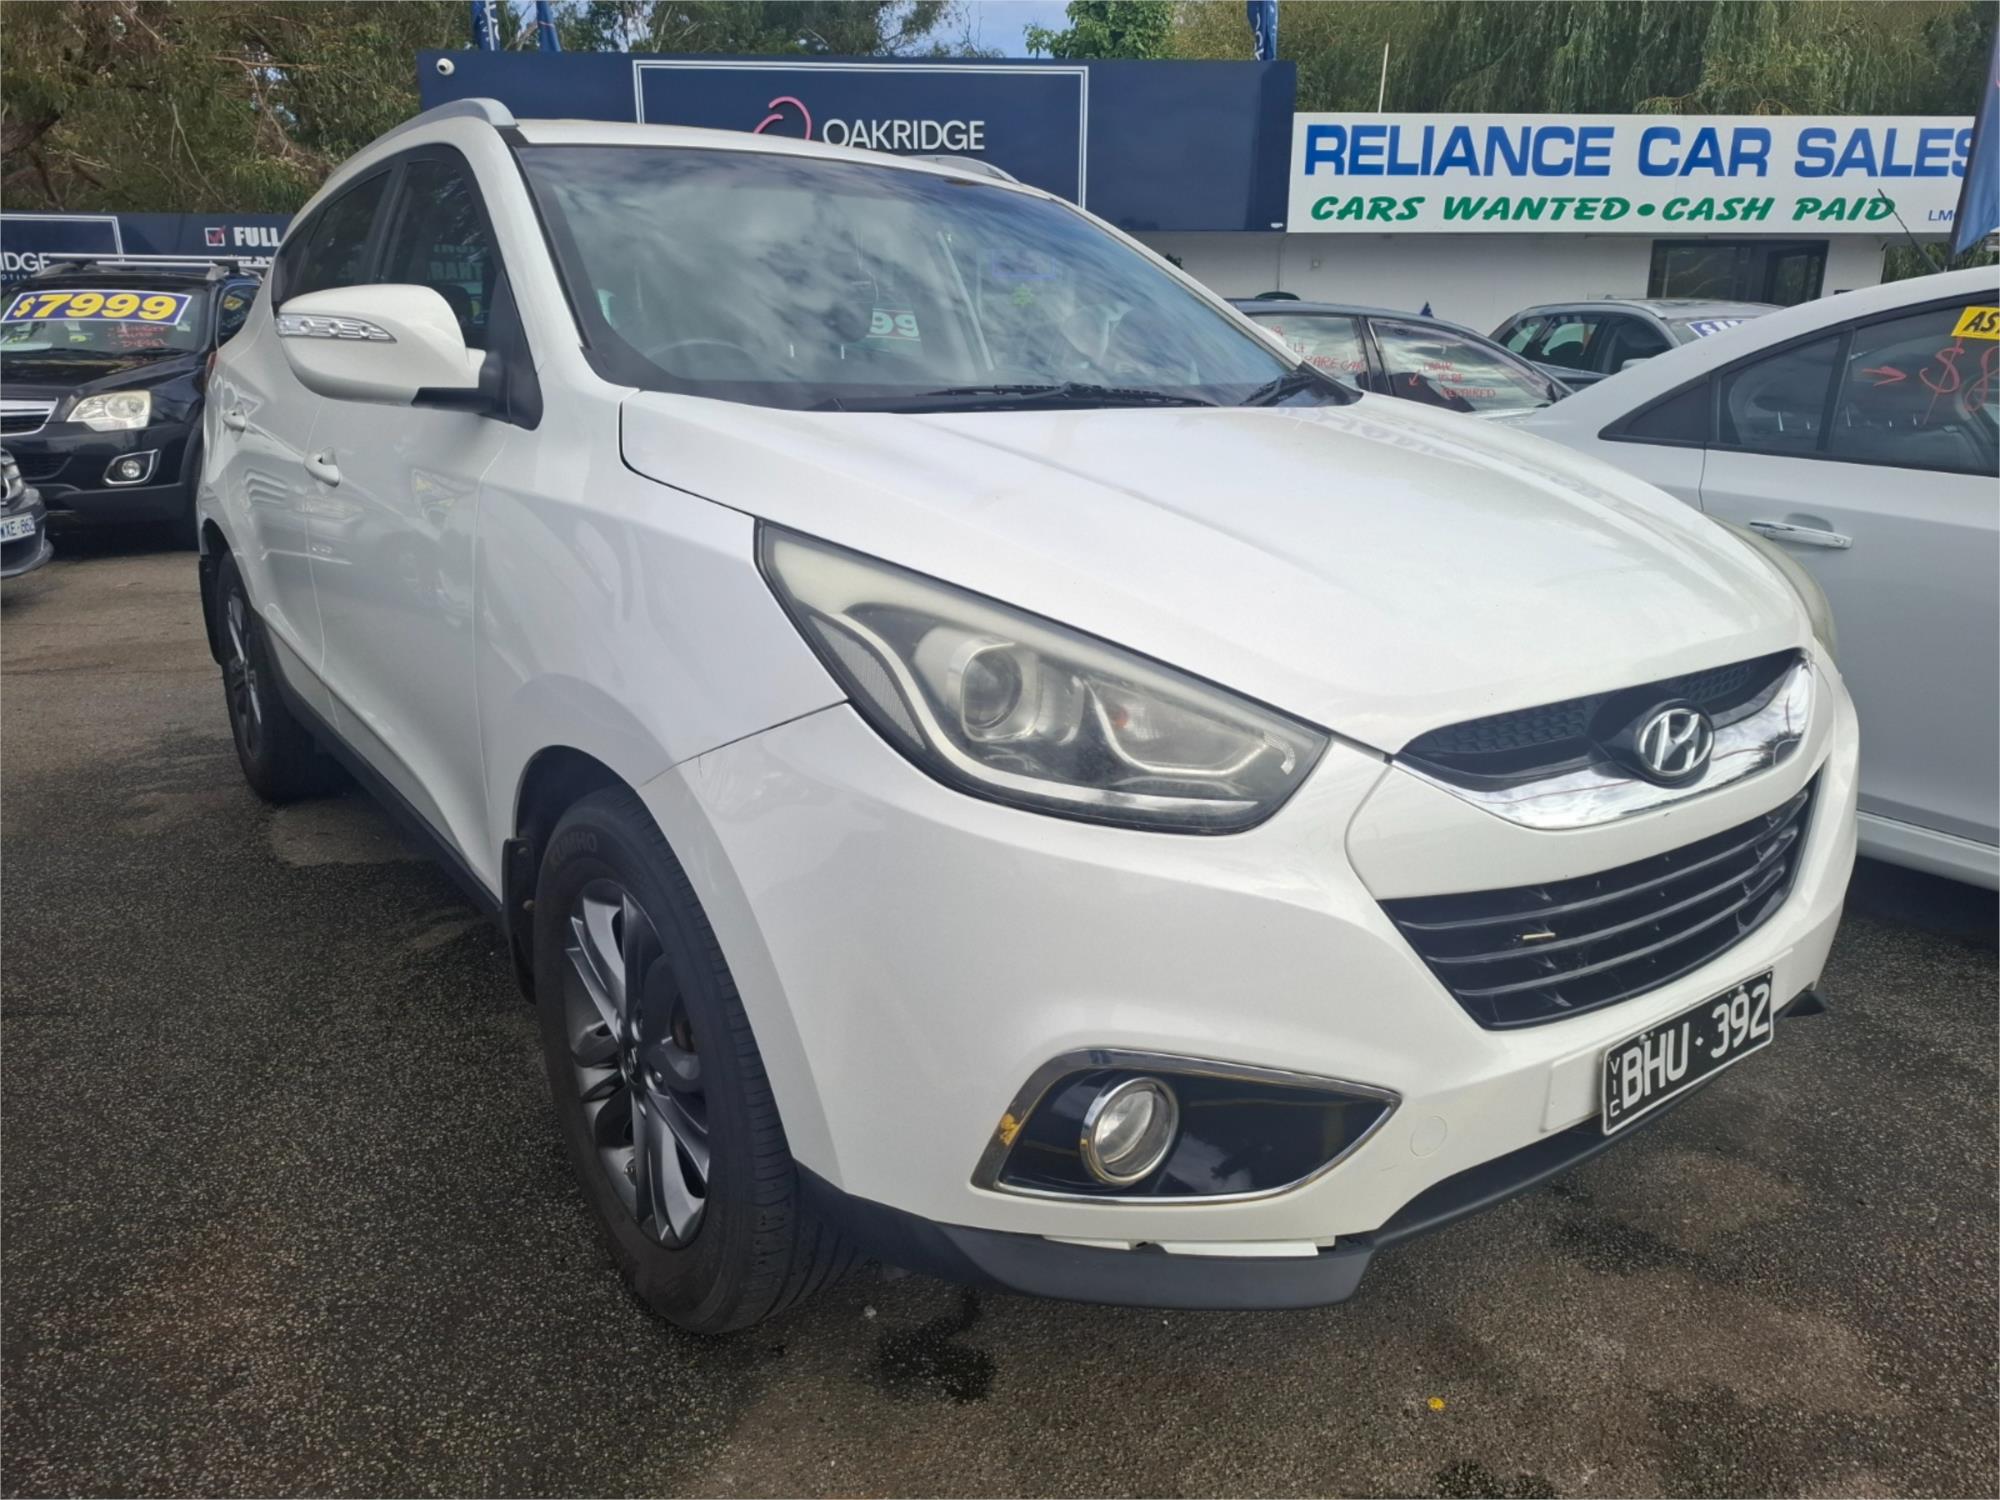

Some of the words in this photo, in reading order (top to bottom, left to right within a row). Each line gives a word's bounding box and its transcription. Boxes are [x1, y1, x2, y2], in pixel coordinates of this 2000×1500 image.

[822, 118, 985, 150] OAKRIDGE
[1304, 124, 1615, 177] RELIANCE
[1638, 126, 1772, 178] CAR
[1794, 127, 1974, 178] SALES
[1311, 196, 1425, 222] CARS
[1442, 196, 1631, 222] WANTED
[1662, 197, 1775, 221] CASH
[1792, 197, 1896, 222] PAID
[1928, 209, 1957, 221] LM
[233, 227, 281, 247] FULL
[13, 293, 177, 320] $7999
[1961, 311, 2000, 333] AS
